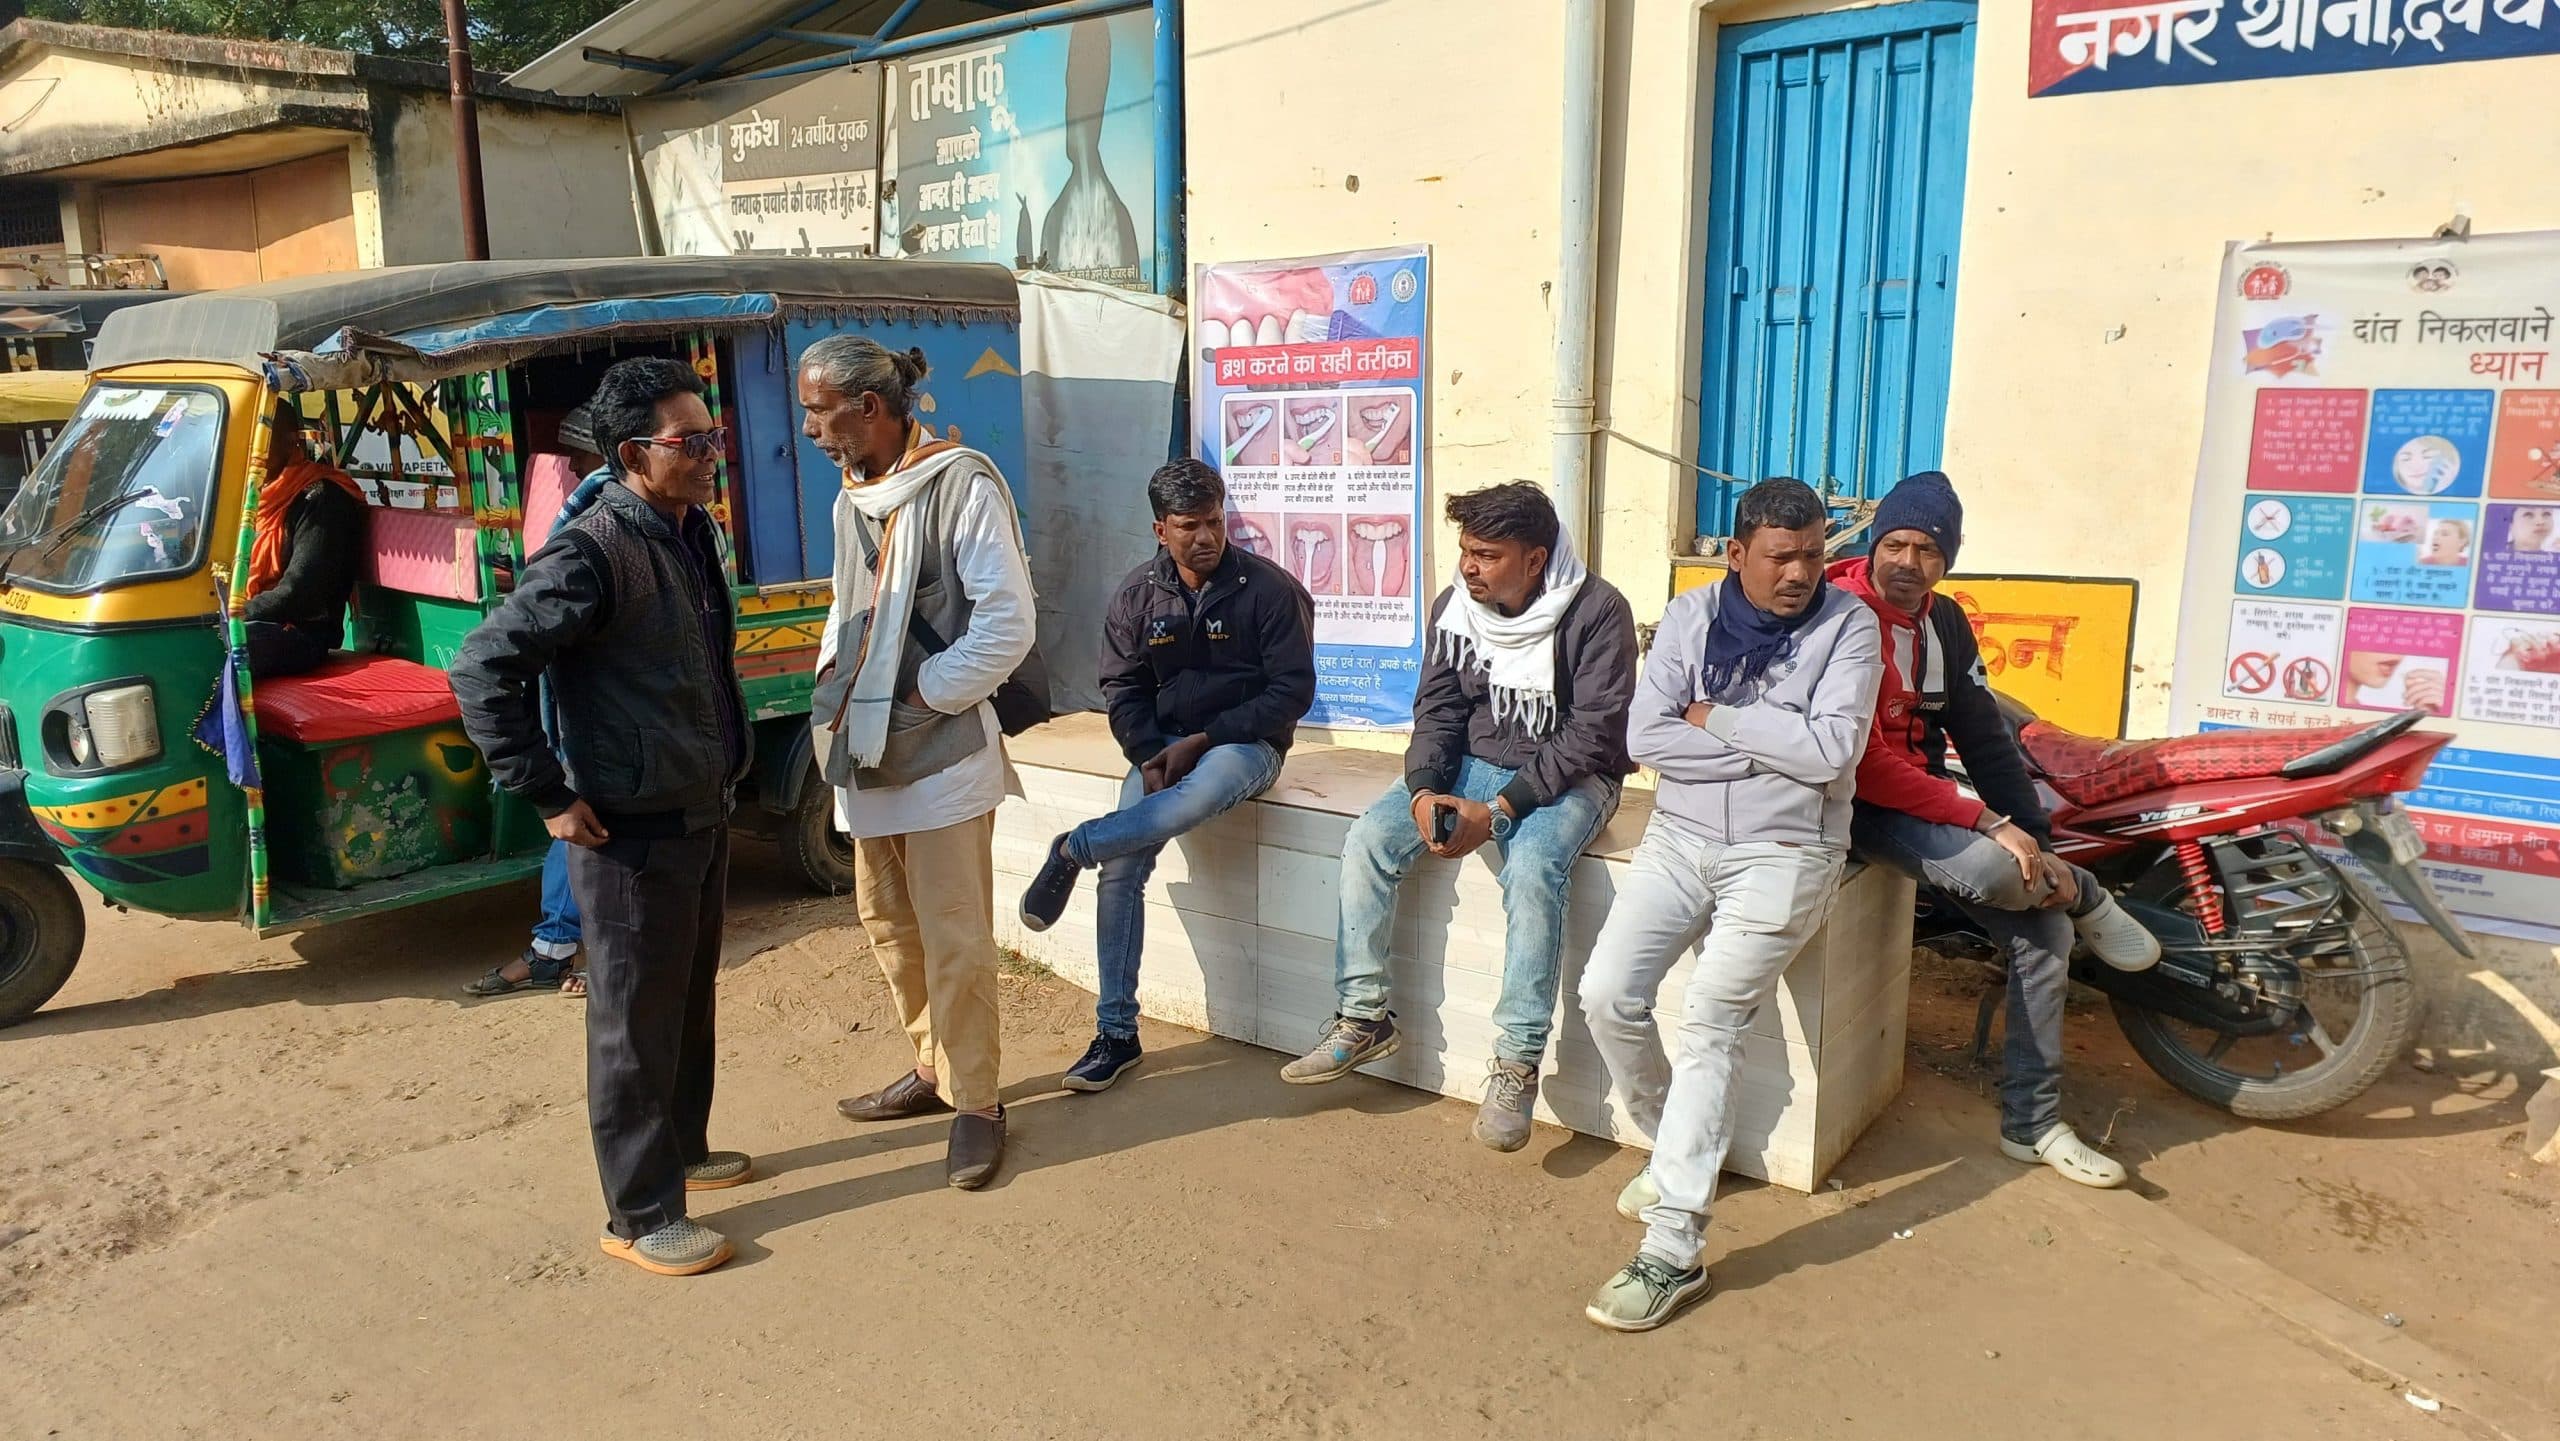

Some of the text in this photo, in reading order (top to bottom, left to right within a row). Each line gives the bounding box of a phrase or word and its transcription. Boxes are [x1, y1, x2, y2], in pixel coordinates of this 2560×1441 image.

[2056, 0, 2222, 71] नगर
[729, 109, 869, 163] मुकेश 24 वर्षीय युवक
[936, 125, 981, 166] आपको
[790, 180, 804, 213] की
[805, 188, 828, 215] वजह
[829, 177, 838, 211] से
[2353, 306, 2555, 344] दांत निकलवाने
[1222, 345, 1413, 379] ब्रश करने का सही तरीका
[2468, 351, 2549, 382] ध्यान
[375, 462, 449, 472] VIAPEETH
[2249, 707, 2259, 723] से
